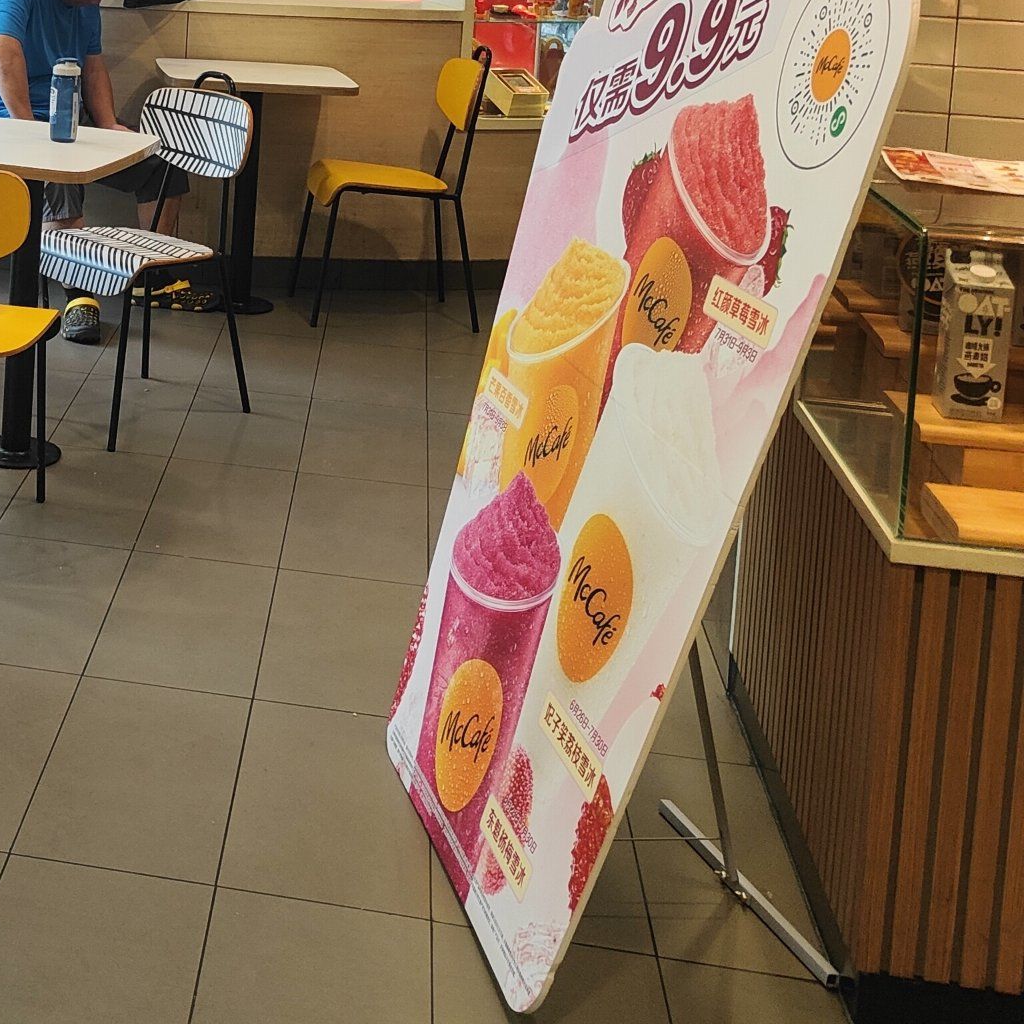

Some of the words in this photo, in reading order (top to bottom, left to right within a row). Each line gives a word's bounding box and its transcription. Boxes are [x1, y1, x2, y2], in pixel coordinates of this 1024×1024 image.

[633, 272, 680, 347] McCafé
[710, 287, 770, 337] 红颜草莓雪冰
[964, 314, 1003, 337] LY!
[523, 416, 573, 468] McCafé
[568, 556, 620, 646] McCafé
[440, 710, 495, 763] McCafé
[543, 702, 598, 789] 妃子笑荔枝雪冰
[569, 698, 609, 757] 6月26日-7月30日
[486, 807, 527, 887] 东魁杨梅雪冰
